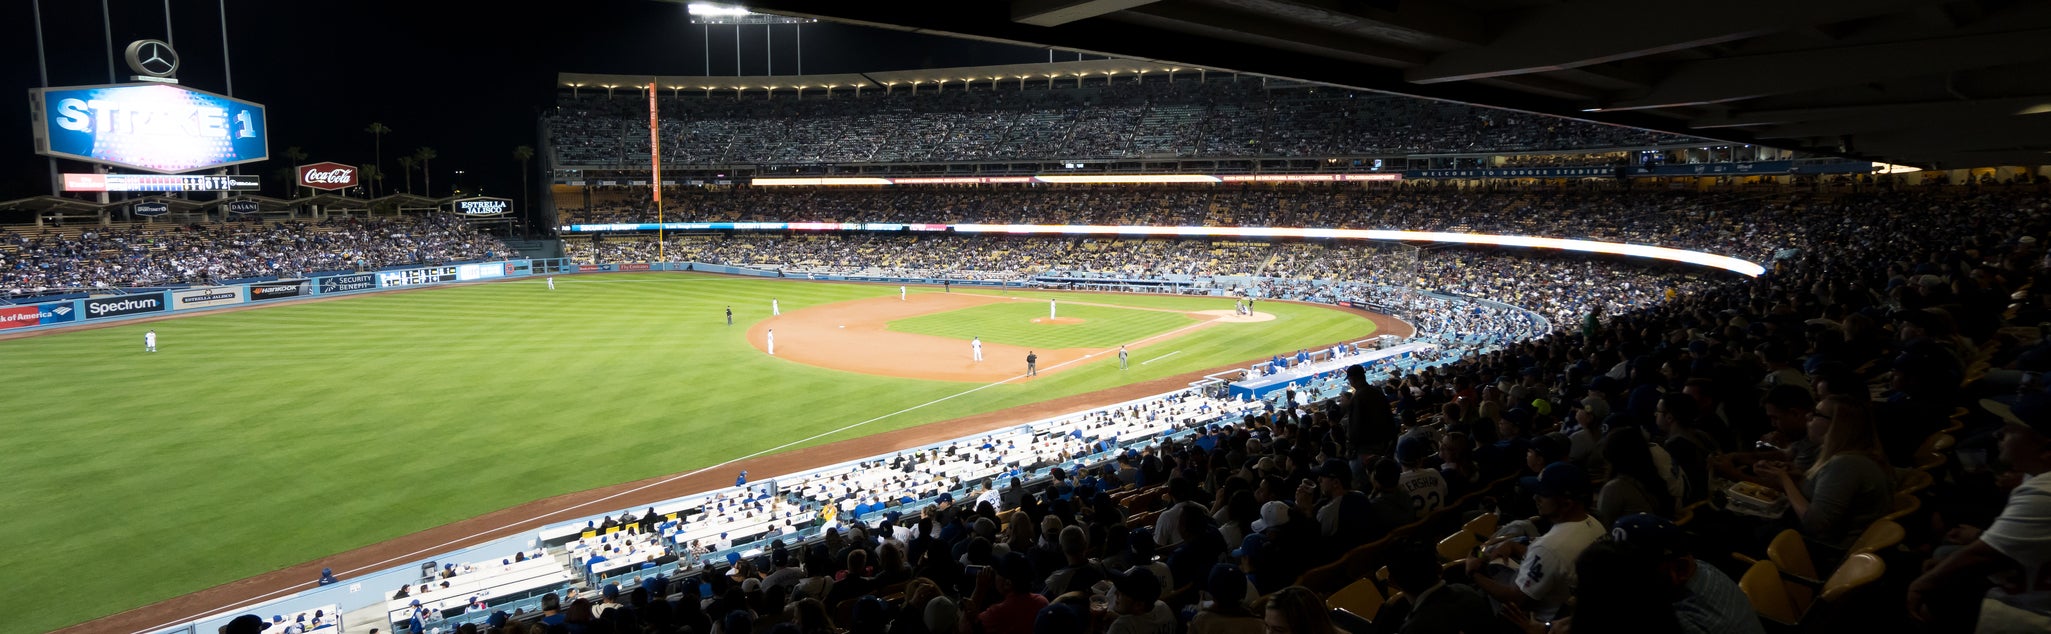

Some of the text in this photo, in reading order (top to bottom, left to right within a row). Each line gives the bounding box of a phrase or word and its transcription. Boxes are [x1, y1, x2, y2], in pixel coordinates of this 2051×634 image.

[235, 109, 257, 139] 1
[304, 168, 353, 184] Coca-Cola
[461, 201, 507, 209] ESTRELLA
[339, 275, 372, 284] SECURITY
[339, 282, 368, 291] BENEFIT
[89, 298, 156, 316] Spectrum
[7, 313, 17, 321] of
[17, 311, 53, 321] America
[1402, 477, 1438, 492] ERSHAW
